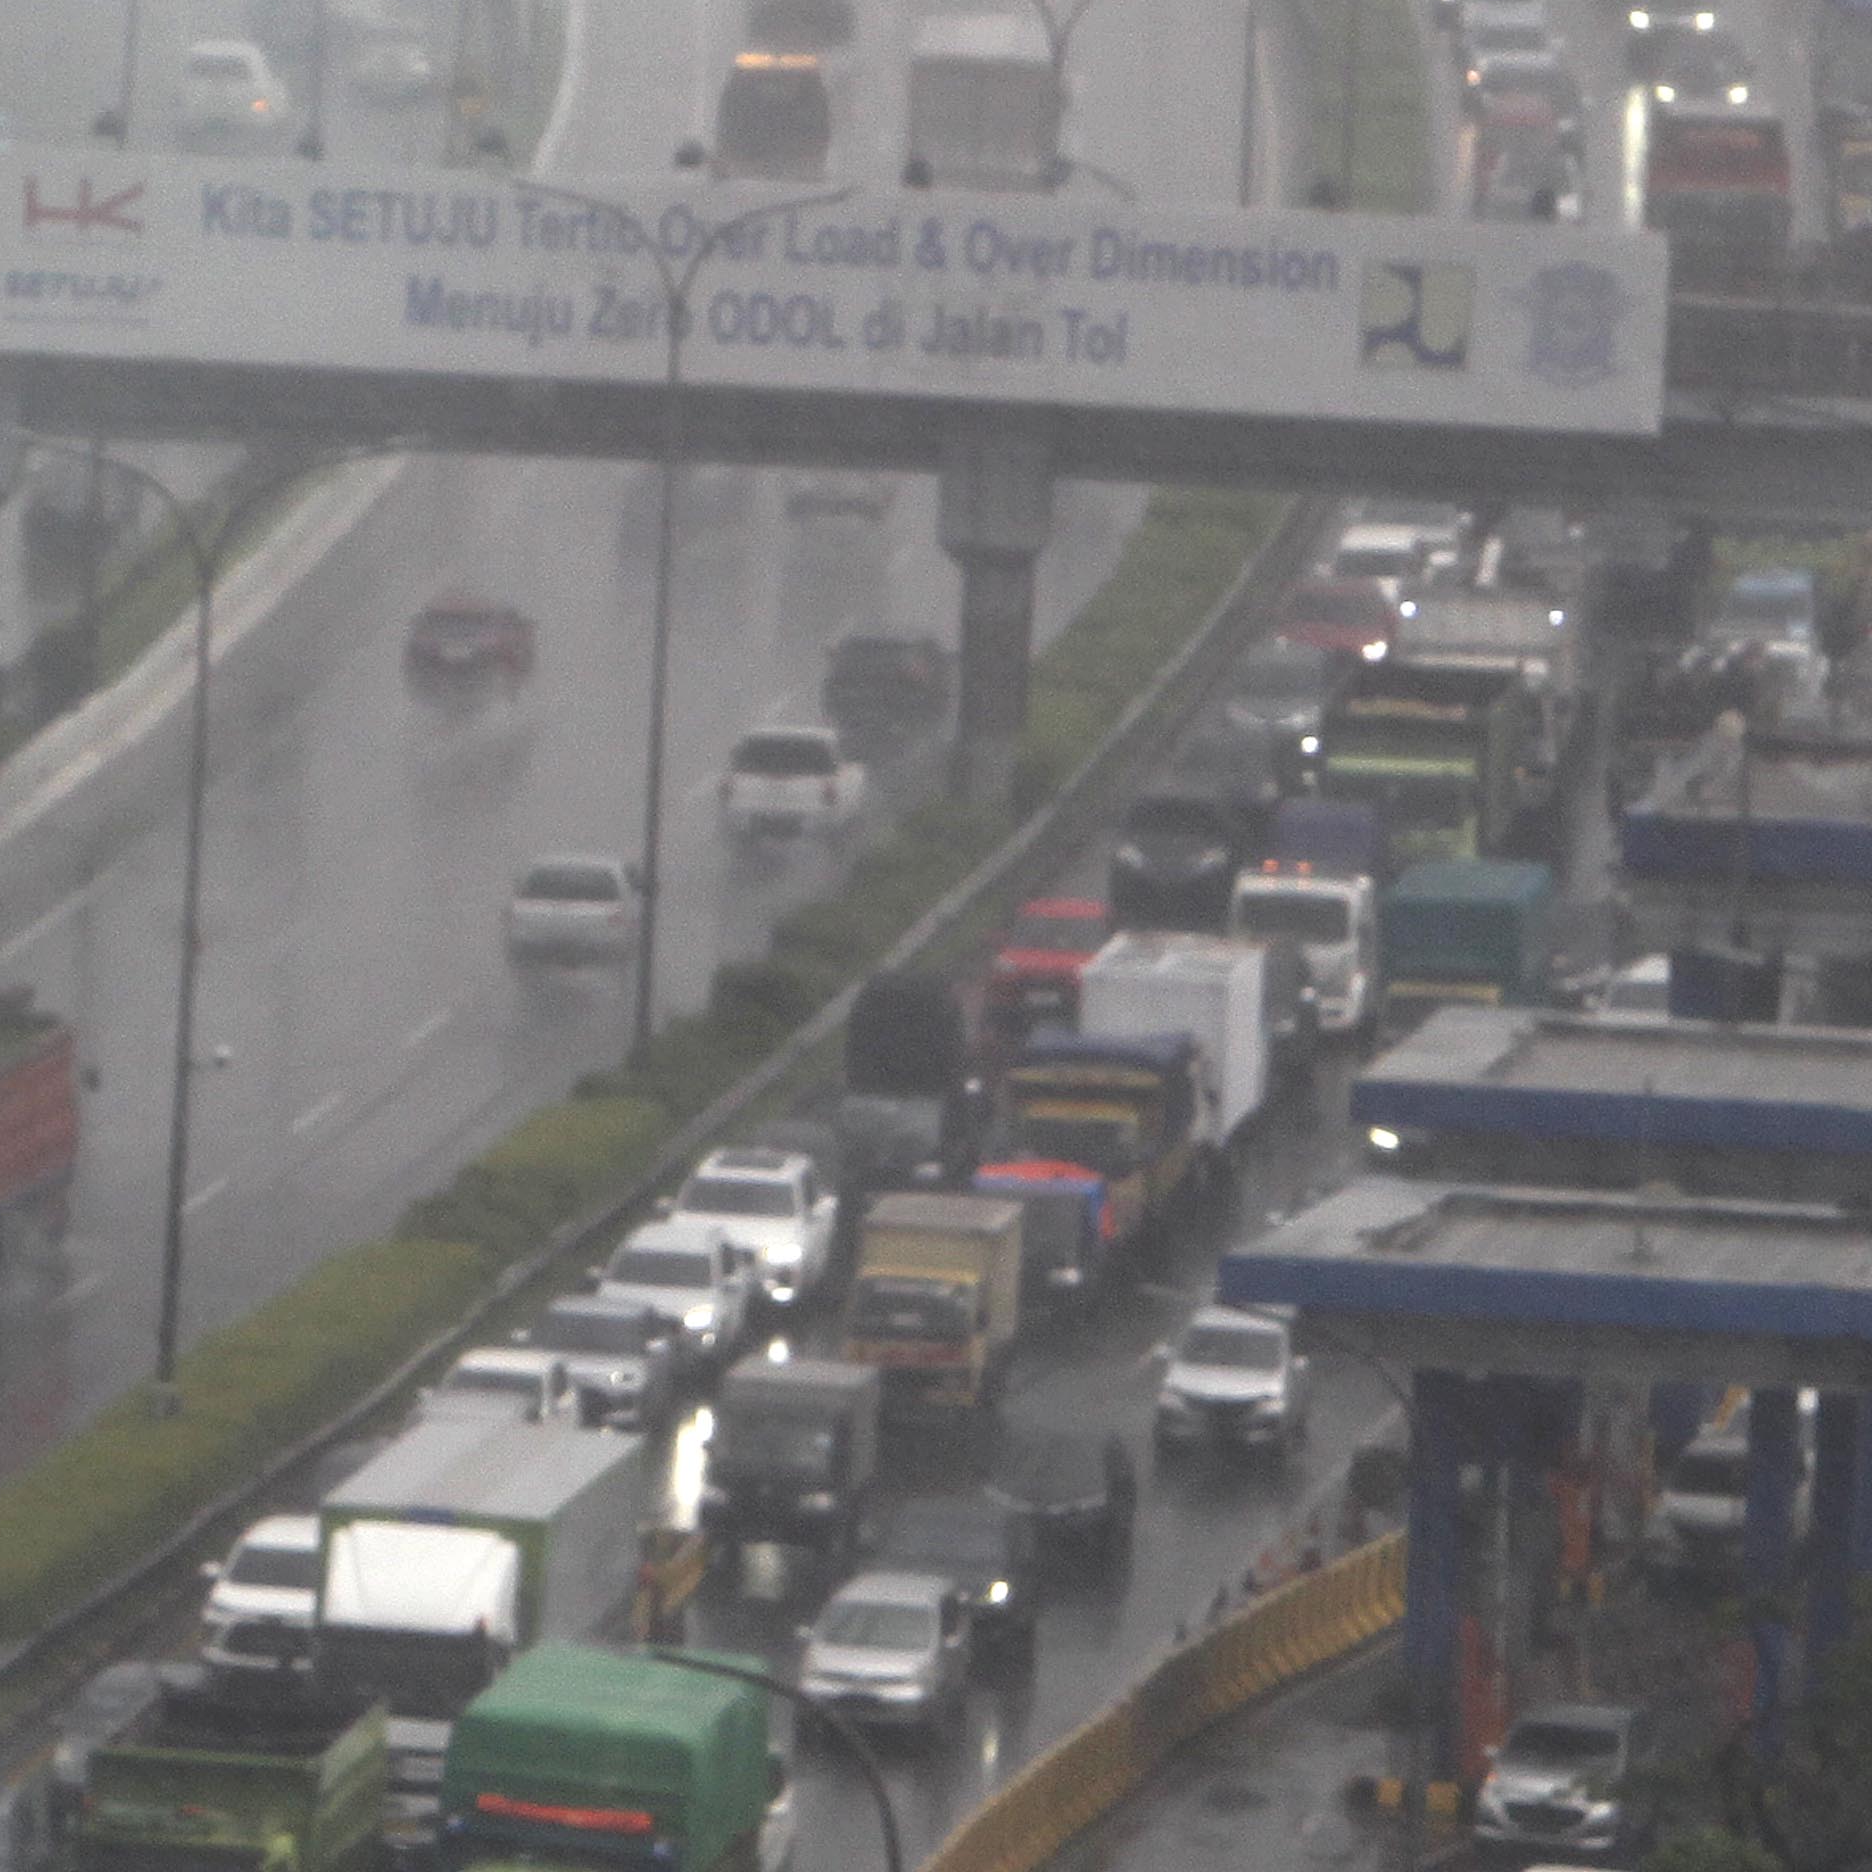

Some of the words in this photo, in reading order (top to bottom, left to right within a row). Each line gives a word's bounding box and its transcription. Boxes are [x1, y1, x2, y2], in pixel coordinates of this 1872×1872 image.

[201, 184, 294, 238] Kita
[308, 189, 500, 247] SETUJU
[512, 198, 640, 250] Tertib
[659, 203, 766, 262] Over
[784, 210, 900, 268] Load
[915, 217, 948, 271] &
[964, 220, 1073, 276] Over
[1091, 229, 1340, 293] Dimension
[404, 274, 575, 346] Menuju
[708, 288, 846, 350] ODOL
[863, 294, 906, 349] di
[920, 302, 1044, 362] Jalan
[1062, 308, 1130, 364] Tol
